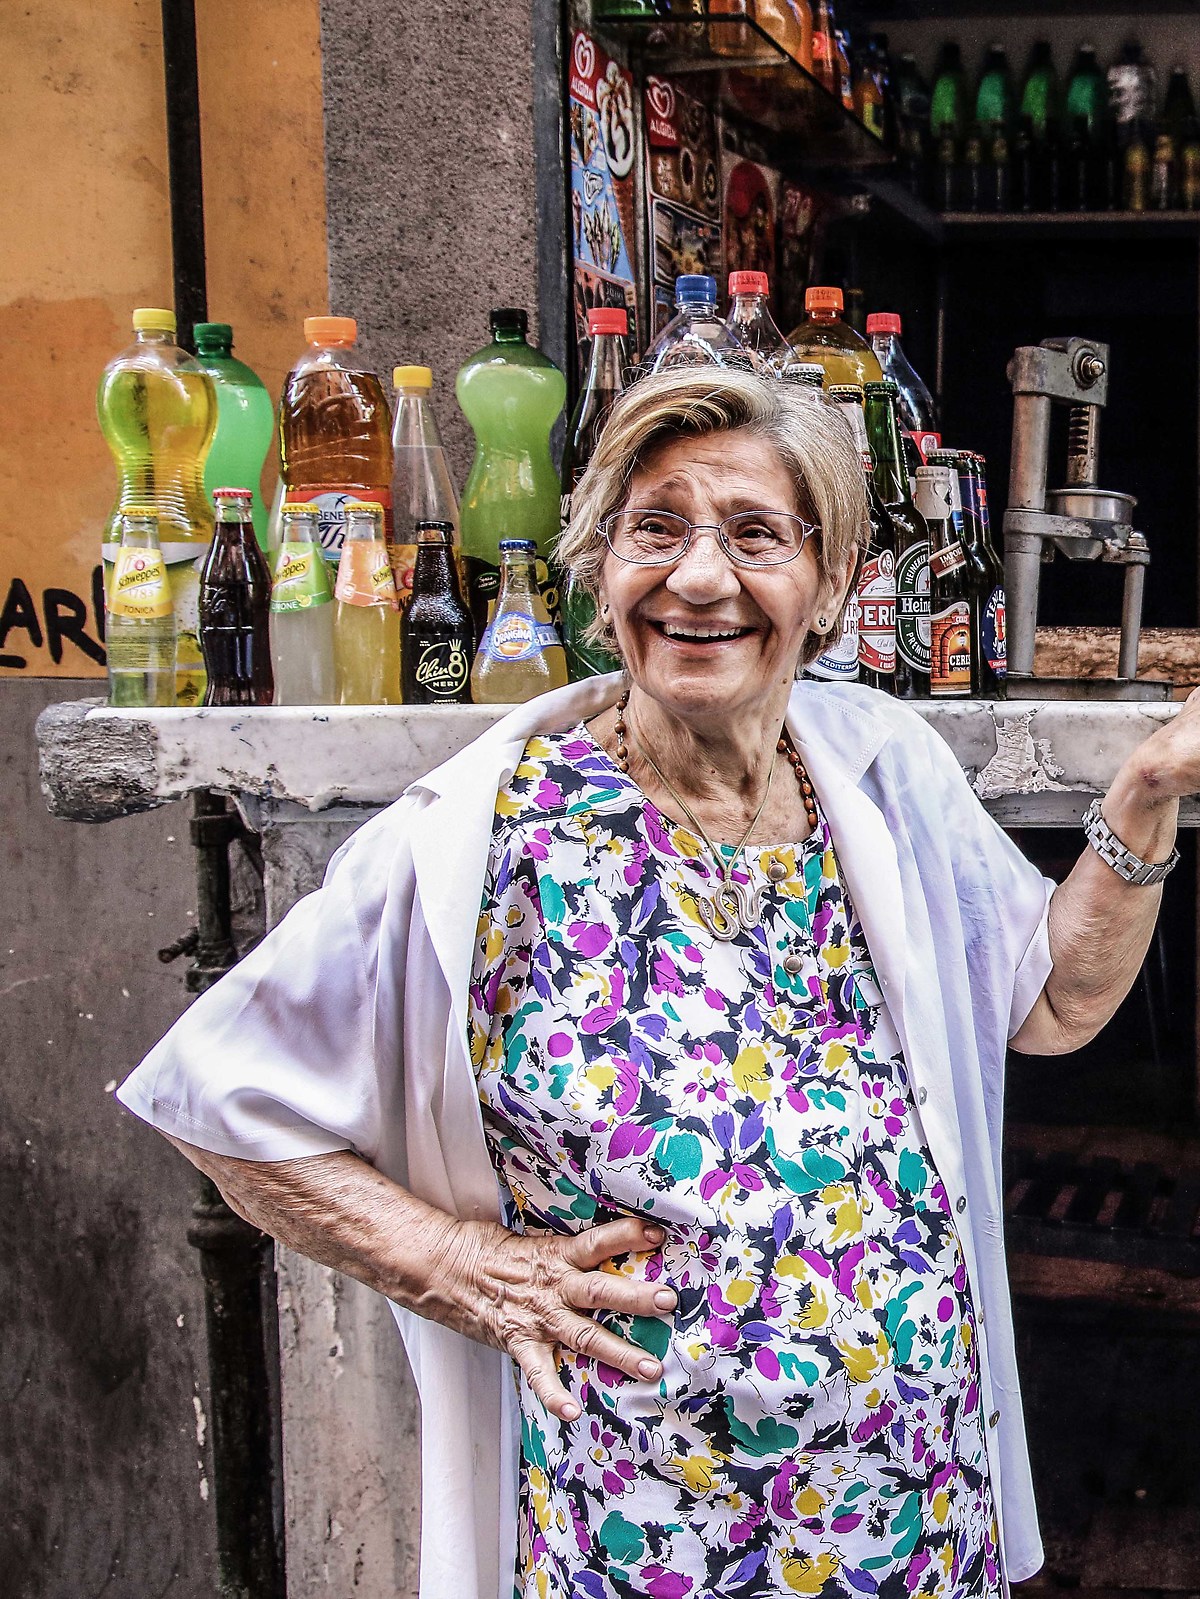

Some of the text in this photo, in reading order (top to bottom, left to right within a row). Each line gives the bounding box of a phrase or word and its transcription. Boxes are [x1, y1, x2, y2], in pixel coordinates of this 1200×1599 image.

[118, 567, 160, 590] Schweppes
[124, 605, 155, 614] TONICA
[494, 629, 532, 647] ORANGINA
